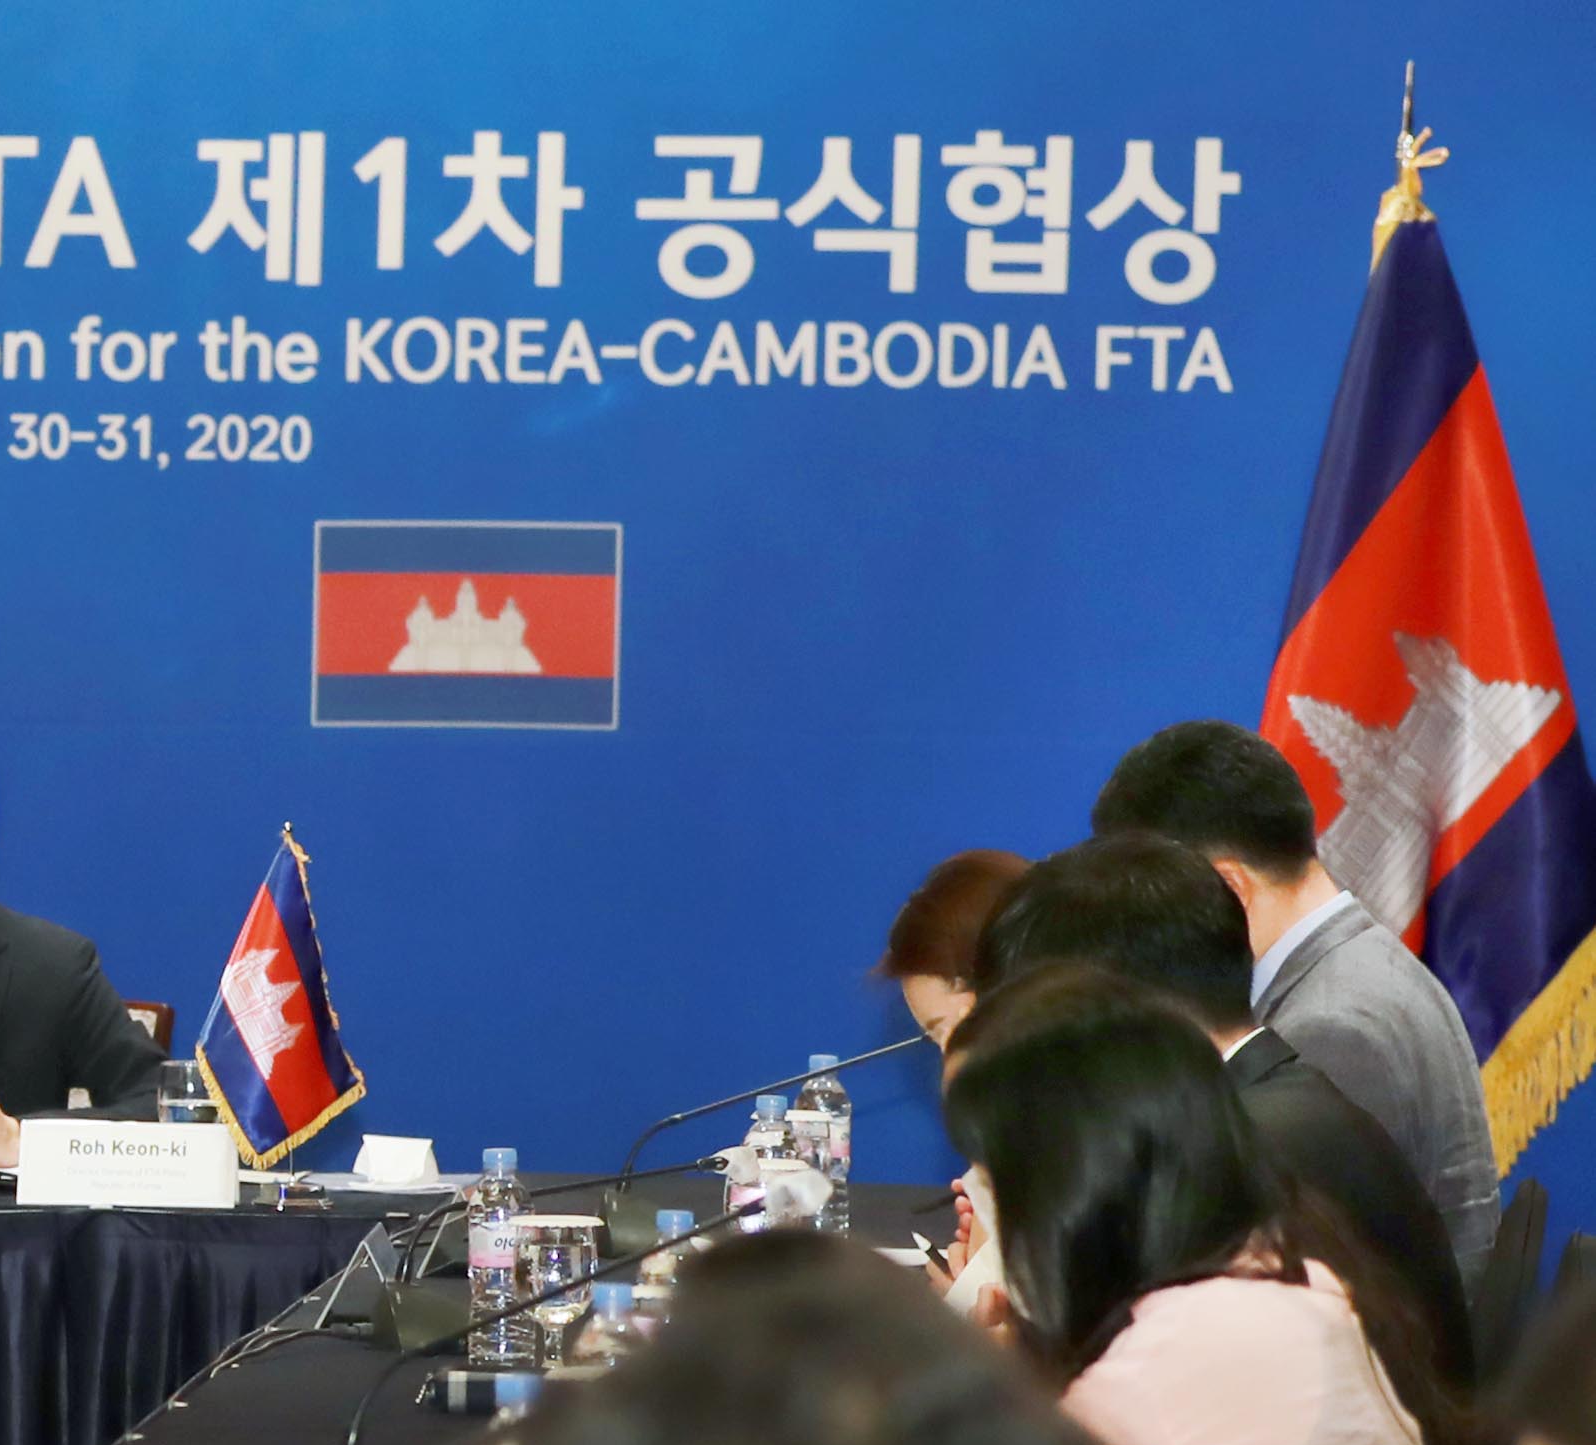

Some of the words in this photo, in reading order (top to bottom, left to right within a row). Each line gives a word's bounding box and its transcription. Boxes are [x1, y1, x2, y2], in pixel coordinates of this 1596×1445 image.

[186, 129, 584, 287] 제1차
[635, 129, 1241, 304] 공식협상
[70, 315, 177, 382] for
[197, 316, 319, 383] the
[344, 317, 1067, 390] KOREA-CAMBODIA
[1094, 326, 1233, 393] FTA
[7, 412, 170, 469] 30-31,
[184, 413, 313, 462] 2020
[68, 1138, 106, 1156] Roh
[111, 1138, 188, 1157] Keon-ki
